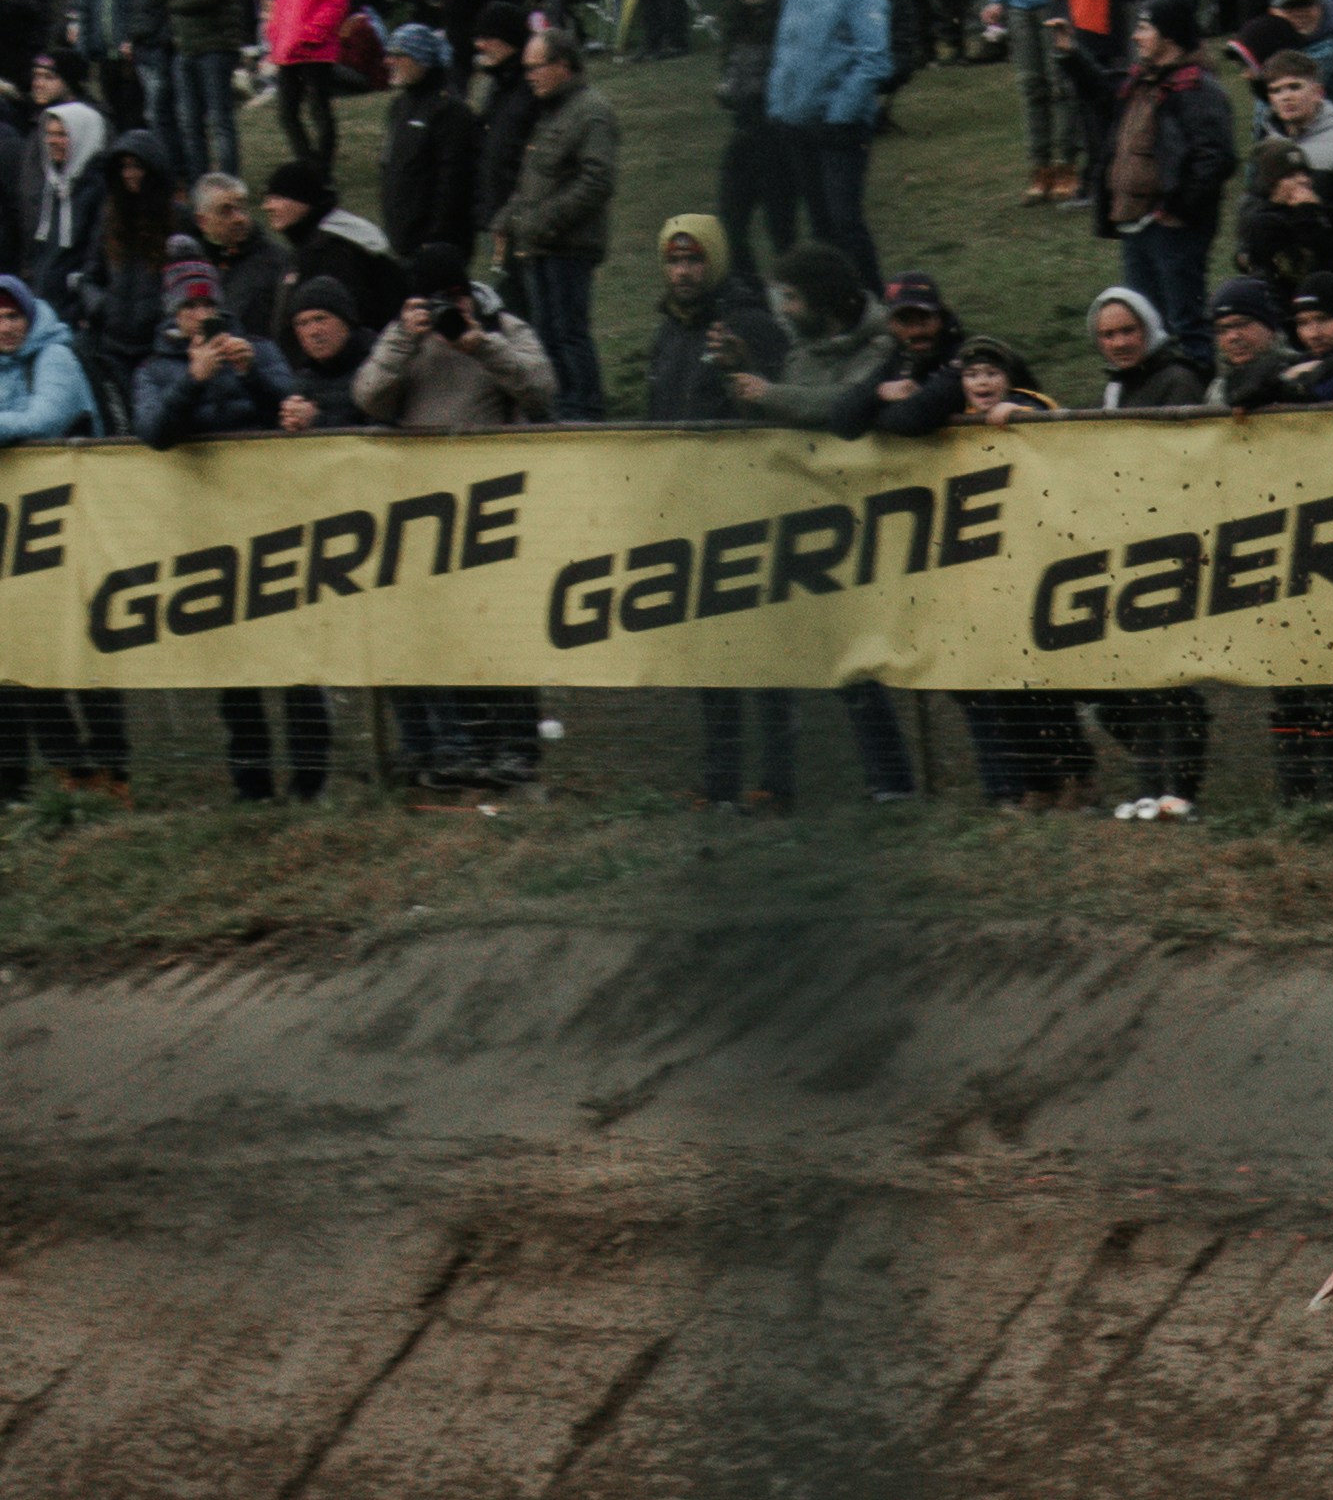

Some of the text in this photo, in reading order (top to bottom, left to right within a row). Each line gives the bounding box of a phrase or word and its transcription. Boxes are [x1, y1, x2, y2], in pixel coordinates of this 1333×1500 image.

[0, 484, 74, 578] E
[87, 471, 527, 654] GAERNE
[548, 464, 1013, 649] GAERNE
